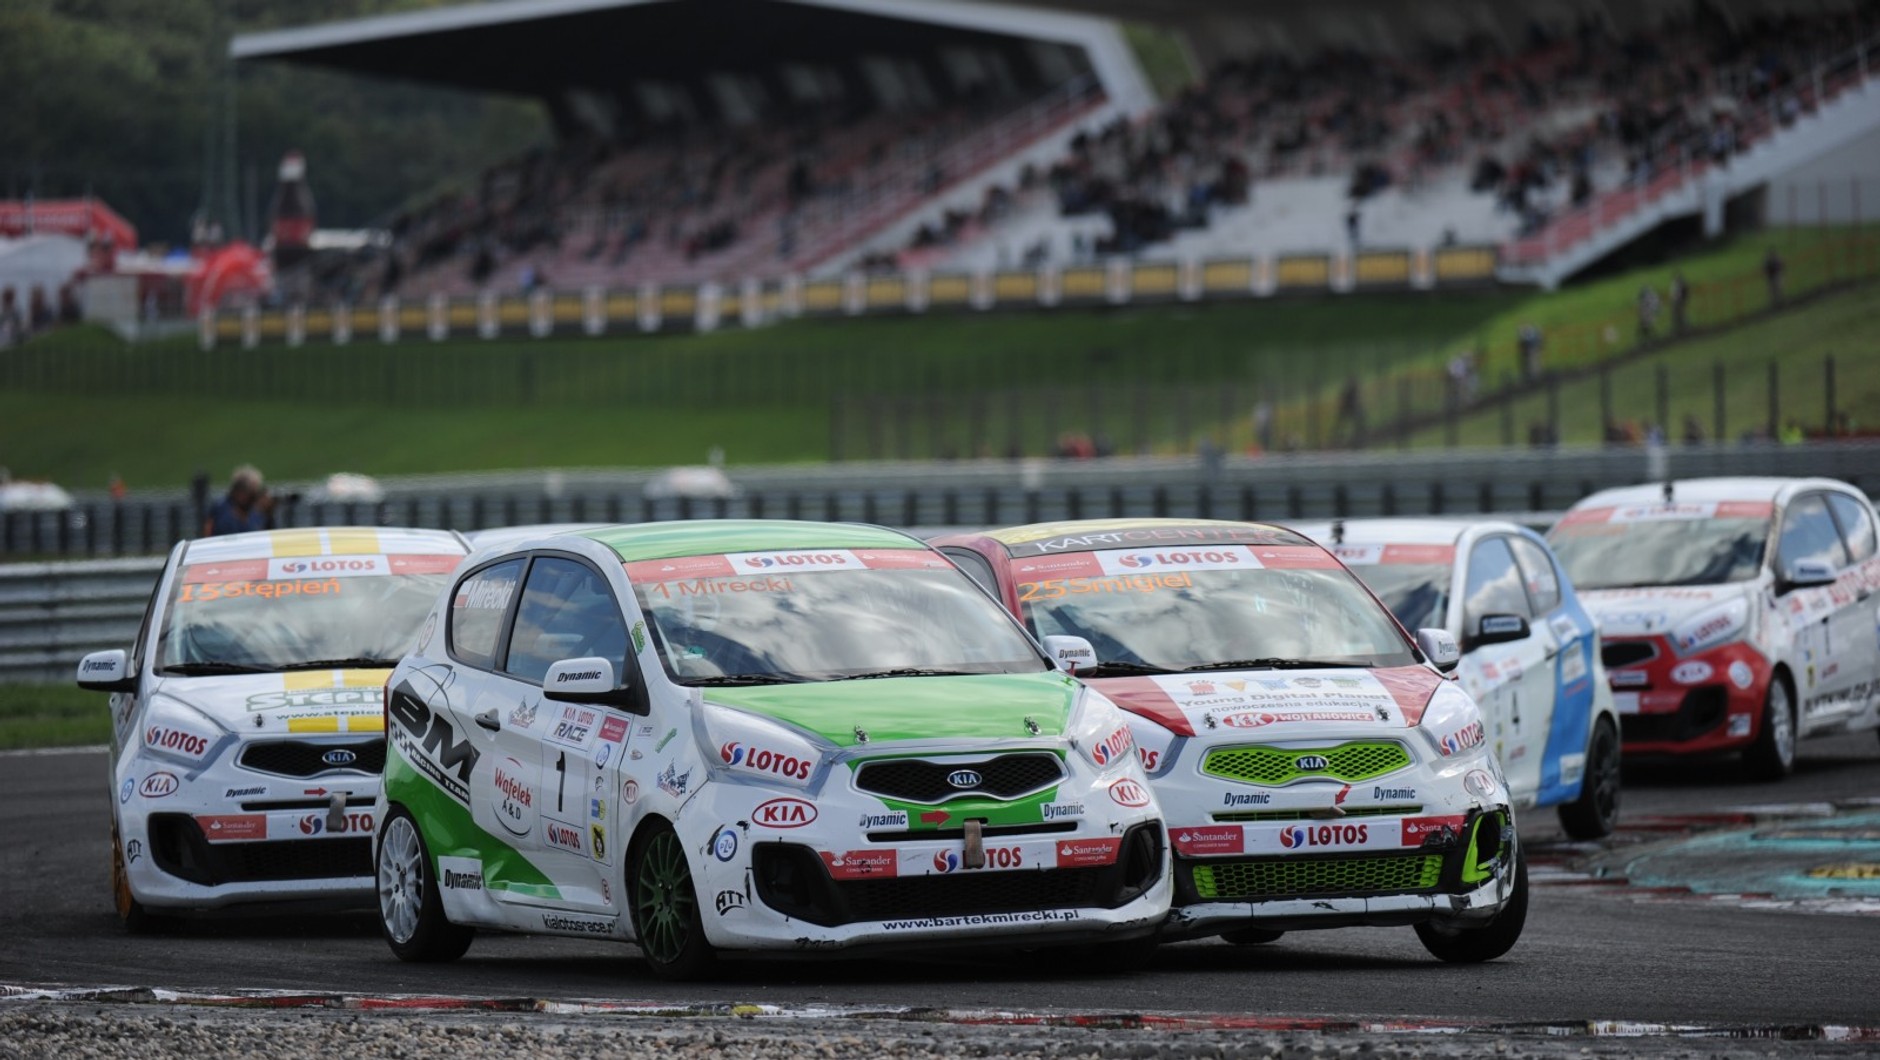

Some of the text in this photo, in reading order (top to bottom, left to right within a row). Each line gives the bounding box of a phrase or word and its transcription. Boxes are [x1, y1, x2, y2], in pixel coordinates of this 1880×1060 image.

[310, 559, 376, 572] LOTOS
[774, 552, 847, 567] LOTOS
[1155, 551, 1240, 566] LOTOS
[653, 576, 795, 599] 1 Mirecki
[1059, 648, 1091, 659] Dynamic
[83, 659, 117, 673] Dynamic
[556, 670, 602, 683] Dynamic
[562, 706, 576, 720] KIA
[389, 678, 481, 788] BM
[552, 721, 588, 742] RACE
[159, 728, 208, 756] LOTOS
[328, 752, 350, 762] KIA
[745, 747, 812, 780] LOTOS
[1299, 756, 1325, 770] KIA
[144, 777, 171, 793] KIA
[556, 750, 566, 813] 1
[953, 773, 979, 785] KIA
[225, 786, 267, 798] Dynamic
[494, 768, 532, 808] Wafelek
[1119, 785, 1142, 801] KIA
[1373, 785, 1417, 801] Dynamic
[1223, 791, 1271, 805] Dynamic
[763, 805, 807, 822] KIA
[1043, 801, 1085, 819] Dynamic
[859, 811, 906, 829] Dynamic
[557, 826, 581, 850] LOTOS
[1192, 830, 1238, 842] Santander
[1308, 824, 1369, 846] LOTOS
[845, 855, 891, 867] Santander
[715, 889, 744, 914] ATT
[882, 909, 1080, 931] www.bartekmirecki.pl
